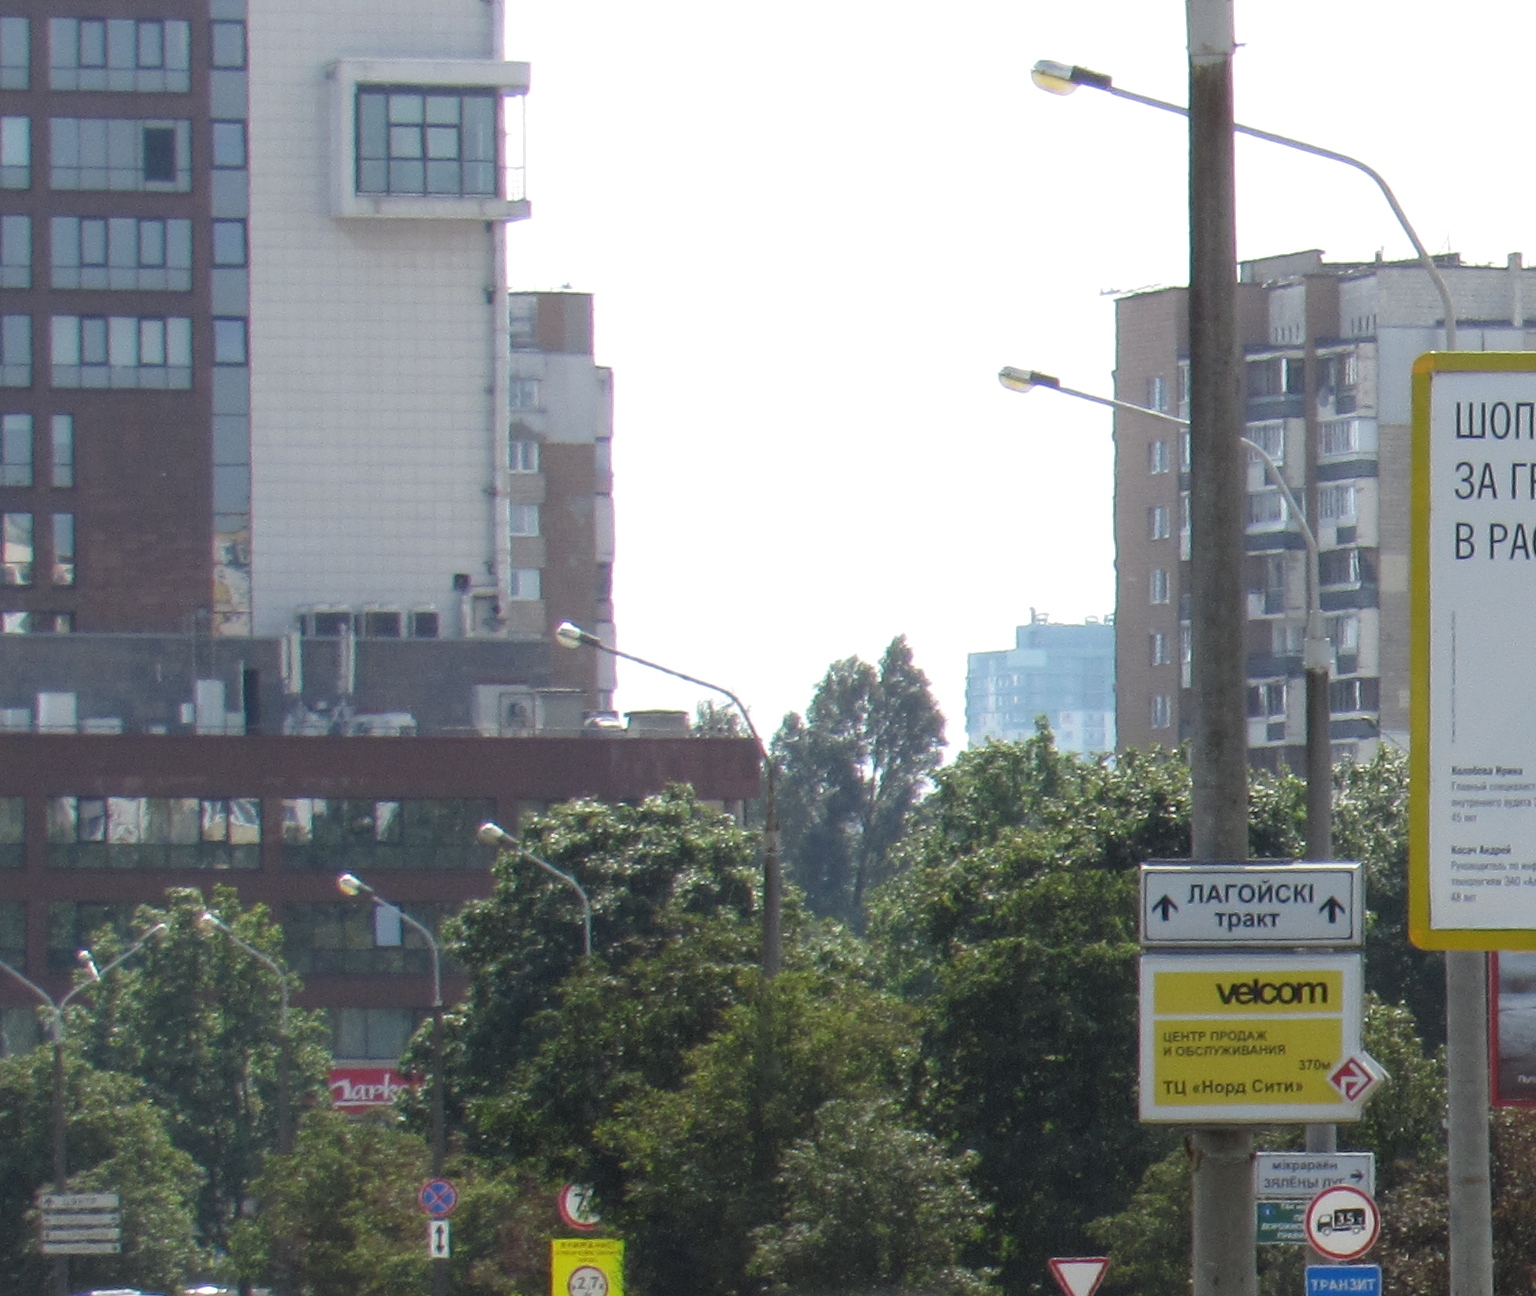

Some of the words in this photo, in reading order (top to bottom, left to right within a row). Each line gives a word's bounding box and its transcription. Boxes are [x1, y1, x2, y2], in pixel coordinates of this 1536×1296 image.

[1455, 463, 1497, 500] ЗА
[1455, 524, 1474, 560] В
[1188, 880, 1314, 905] ЛАГОЙСКІ
[1215, 912, 1280, 932] тракт
[1216, 979, 1328, 1005] velcom
[1163, 1031, 1206, 1043] ЦЕНТР
[1210, 1030, 1267, 1043] ПРОДАЖ
[1163, 1046, 1173, 1056] И
[1176, 1044, 1286, 1057] ОБСЛУЖИВАНИЯ
[1163, 1081, 1186, 1096] ТЦ
[1193, 1081, 1246, 1096] «Норд
[1252, 1080, 1303, 1094] Сити»
[1311, 1278, 1376, 1291] ТРАНЗИТ
